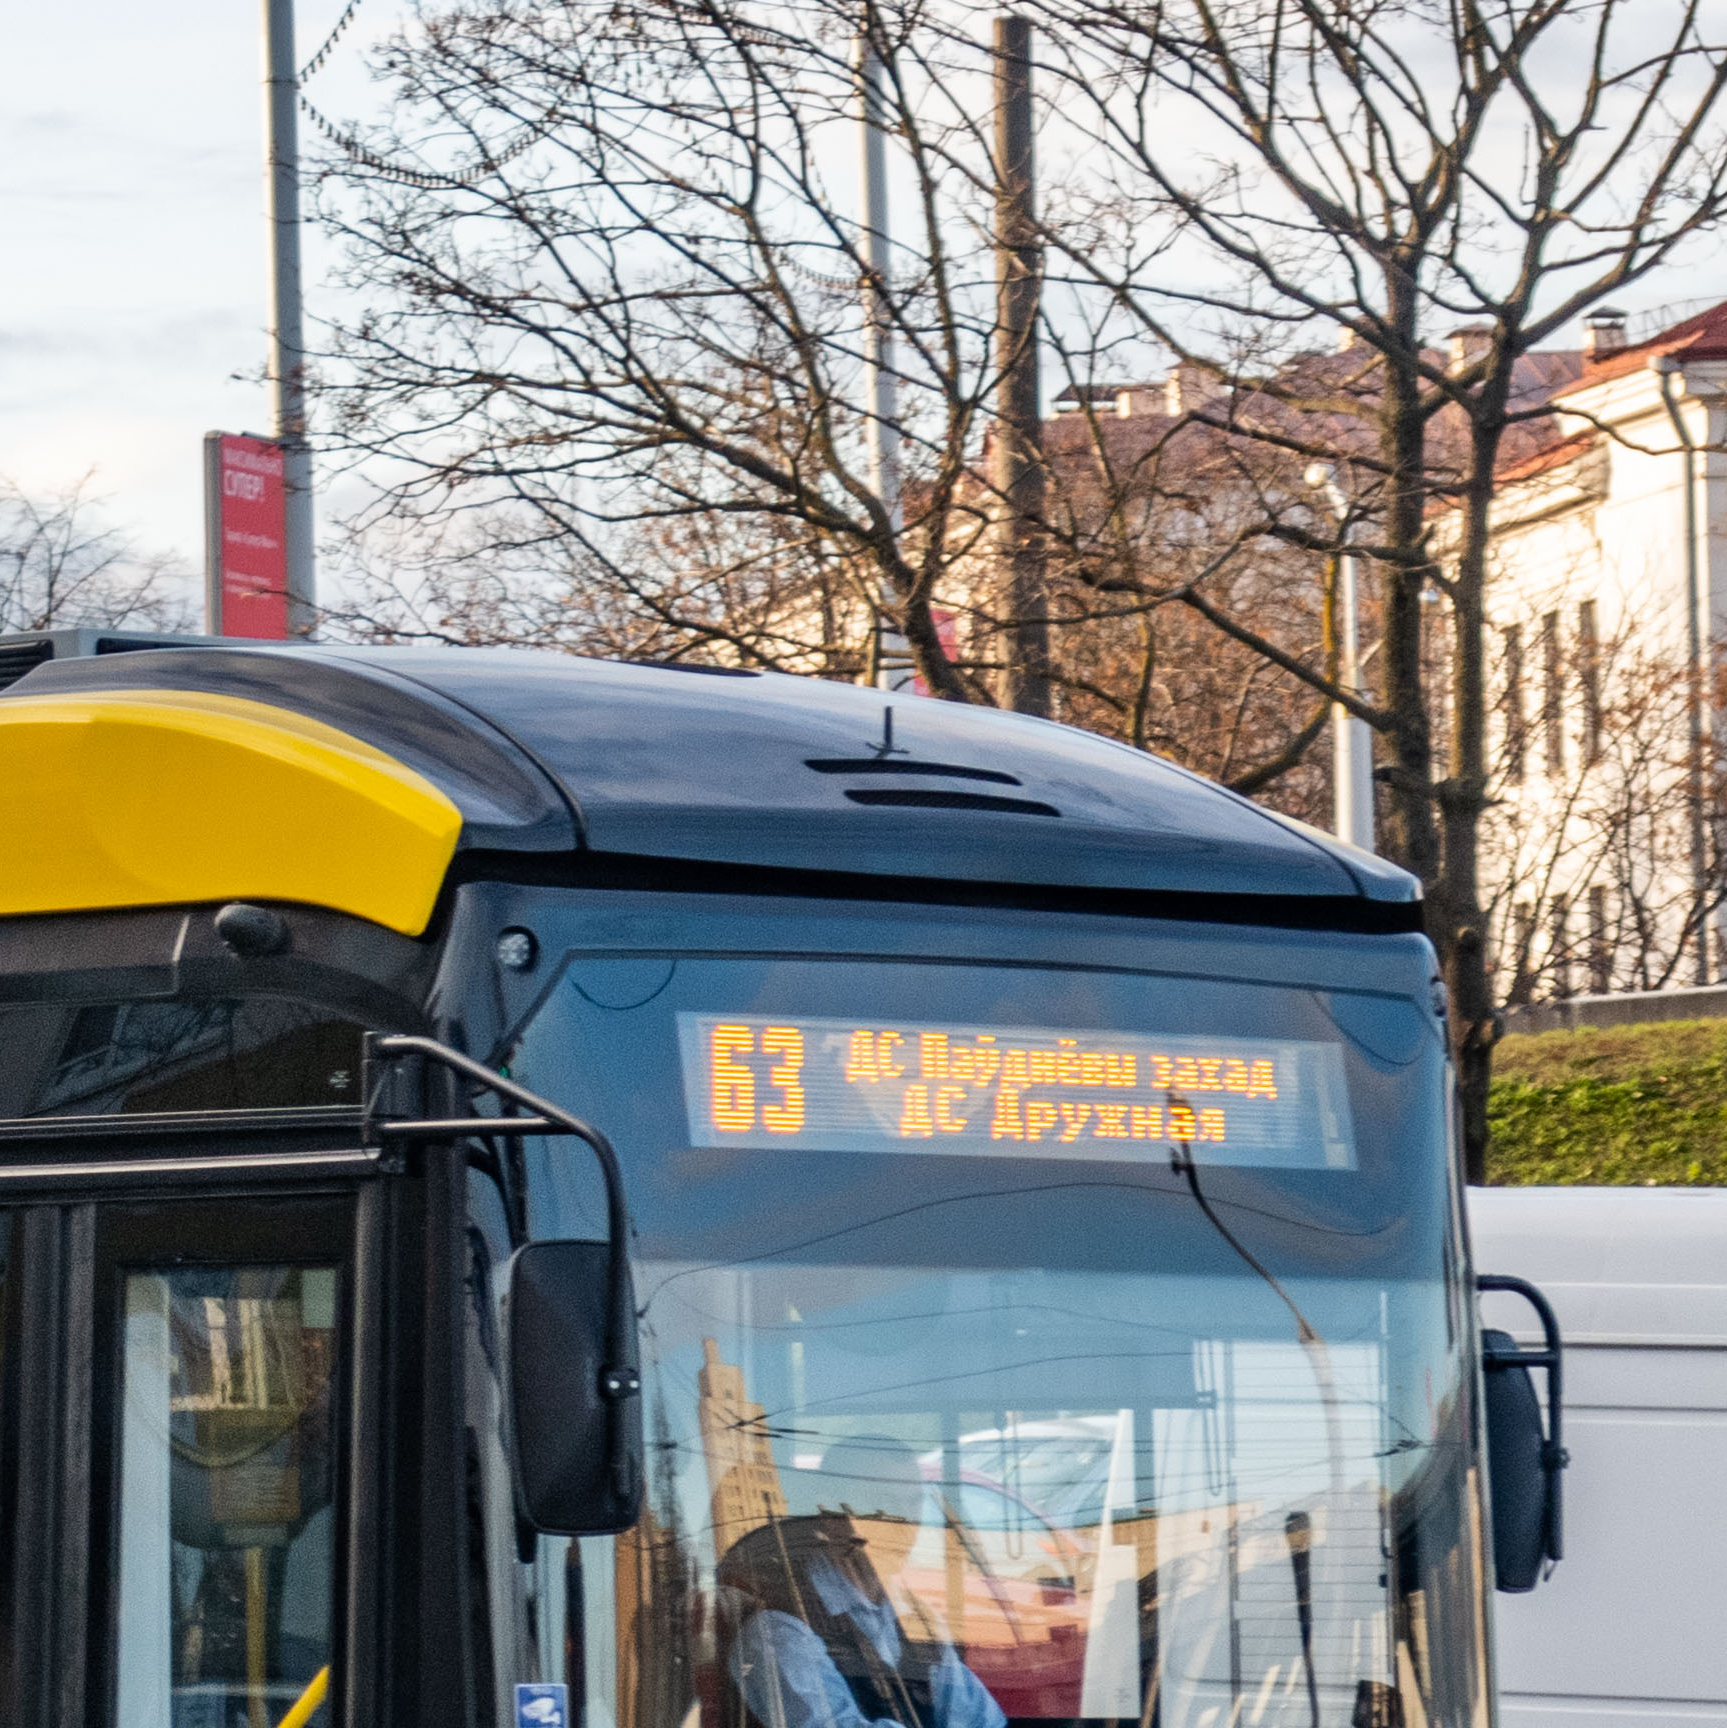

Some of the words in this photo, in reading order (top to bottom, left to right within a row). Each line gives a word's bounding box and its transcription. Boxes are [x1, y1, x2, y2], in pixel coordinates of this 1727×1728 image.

[711, 1023, 806, 1134] 63
[846, 1029, 906, 1084] ДС
[1150, 1054, 1279, 1101] захад
[899, 1083, 970, 1139] ДС
[991, 1082, 1228, 1143] Дружная
